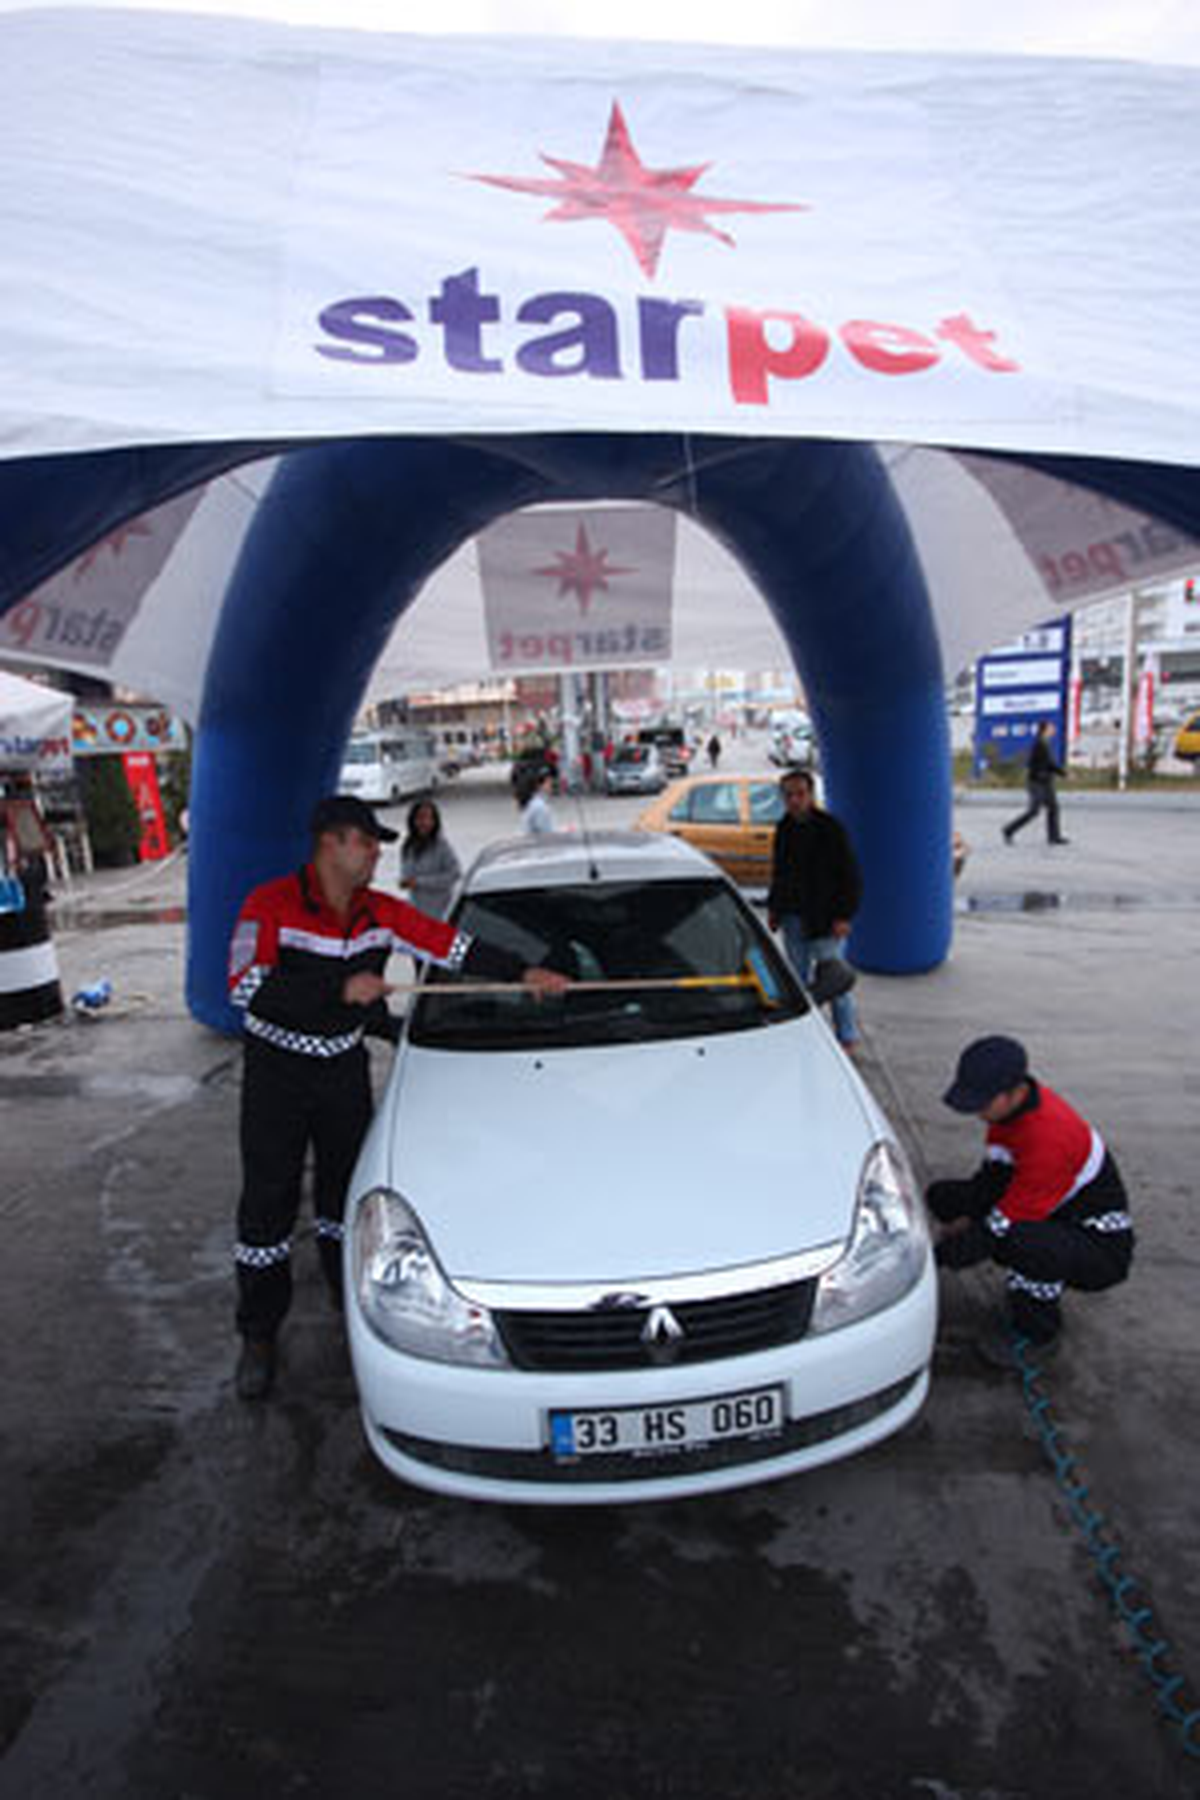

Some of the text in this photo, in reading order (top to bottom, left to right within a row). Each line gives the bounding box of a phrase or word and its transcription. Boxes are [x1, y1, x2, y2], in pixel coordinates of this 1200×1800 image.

[313, 266, 1021, 406] starpet
[576, 1394, 774, 1449] 33 HS 060
